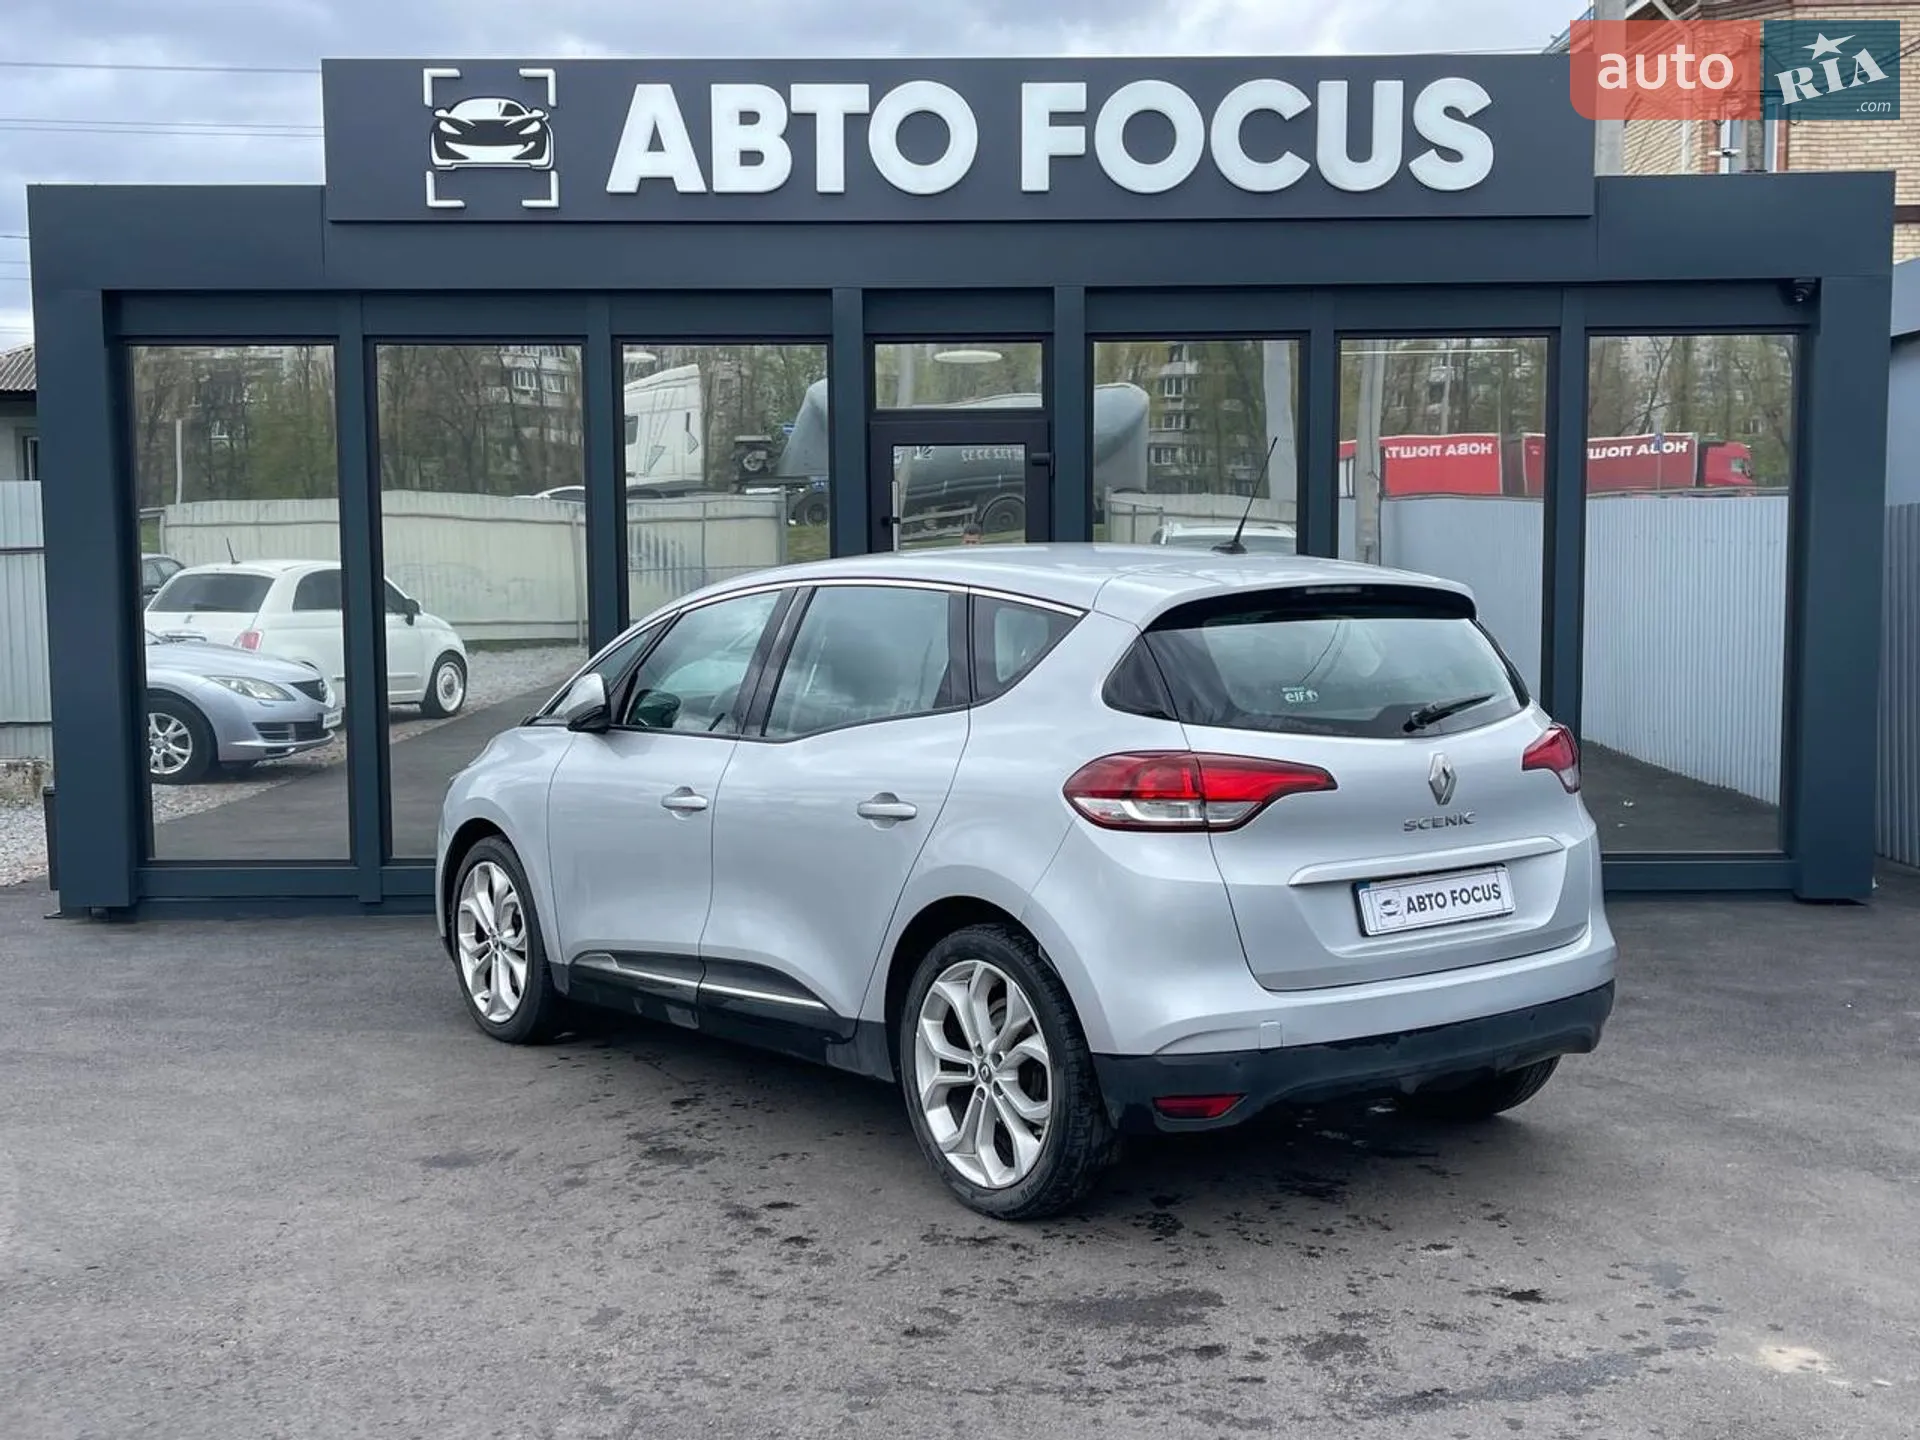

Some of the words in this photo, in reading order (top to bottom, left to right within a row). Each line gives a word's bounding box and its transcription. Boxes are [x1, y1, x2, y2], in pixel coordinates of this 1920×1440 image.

[605, 80, 979, 195] АВТО
[1020, 77, 1494, 194] FOCUS
[1403, 811, 1477, 833] SCENIC
[1406, 891, 1447, 914] АВТО
[1450, 882, 1502, 906] FOCUS
